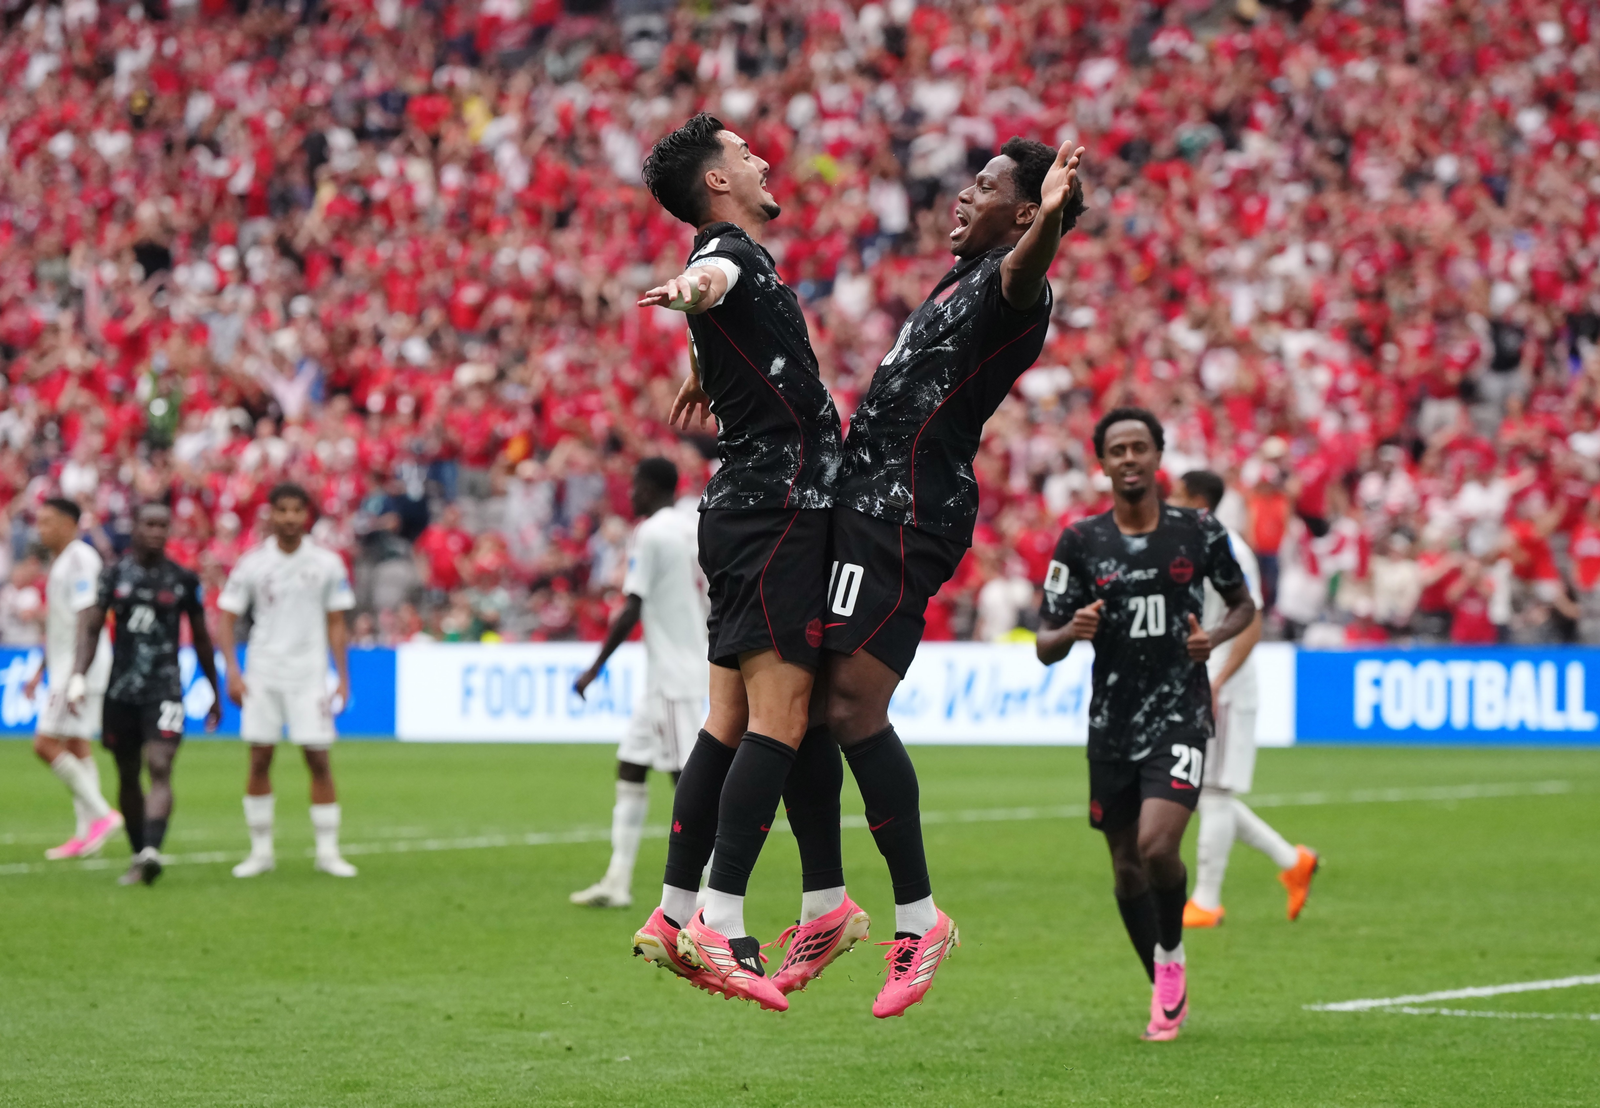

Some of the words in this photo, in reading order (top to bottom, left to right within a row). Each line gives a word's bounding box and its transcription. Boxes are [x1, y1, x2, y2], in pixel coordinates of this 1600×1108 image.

[1128, 594, 1166, 638] 20
[459, 663, 634, 718] FOOTBAL
[1354, 659, 1598, 731] FOOTBALL
[1170, 744, 1203, 788] 20
